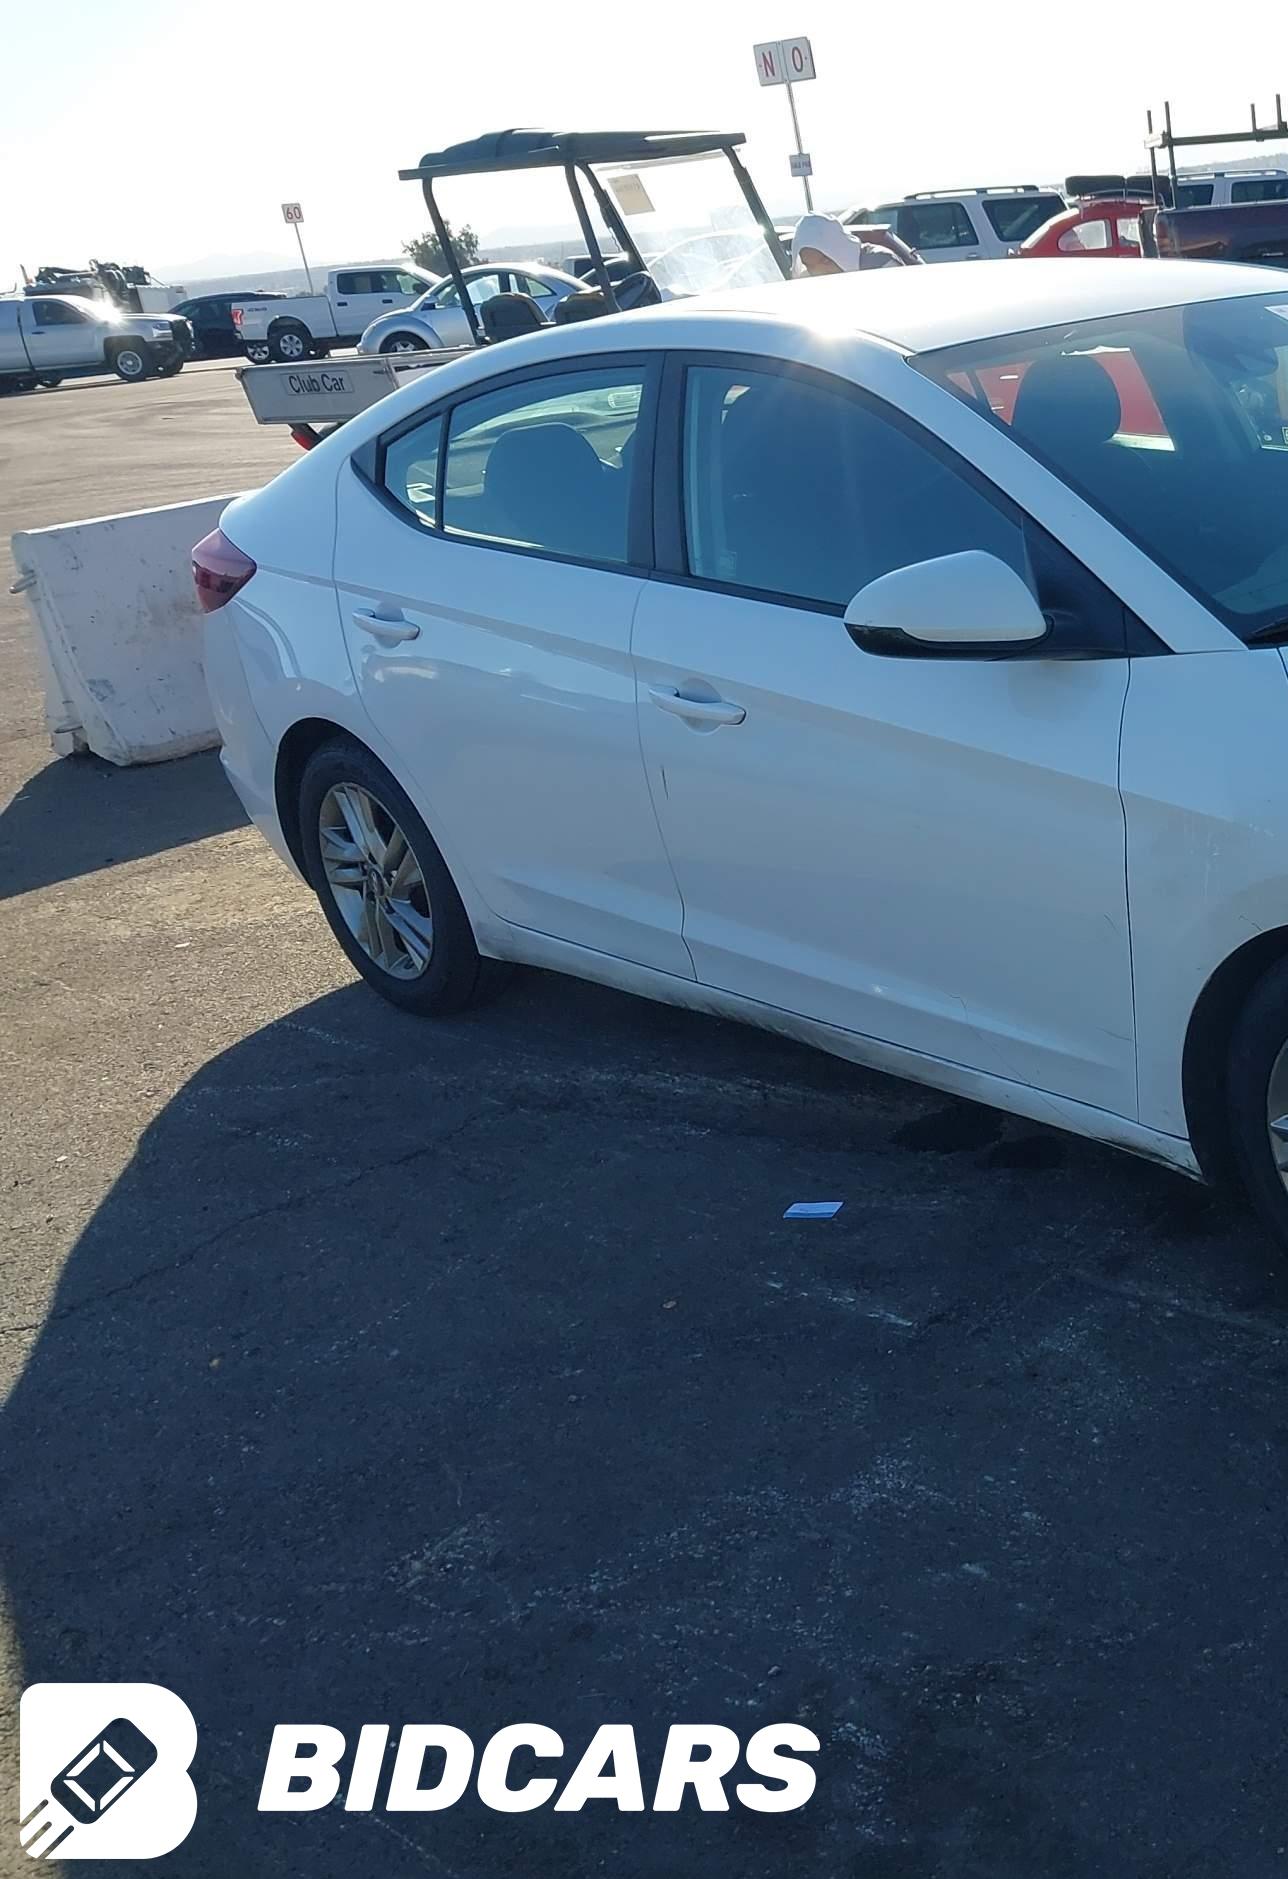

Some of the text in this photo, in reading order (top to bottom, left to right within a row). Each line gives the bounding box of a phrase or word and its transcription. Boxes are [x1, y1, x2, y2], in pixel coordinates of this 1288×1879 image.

[762, 50, 776, 78] N
[286, 206, 302, 220] 60
[288, 373, 345, 393] Club Car
